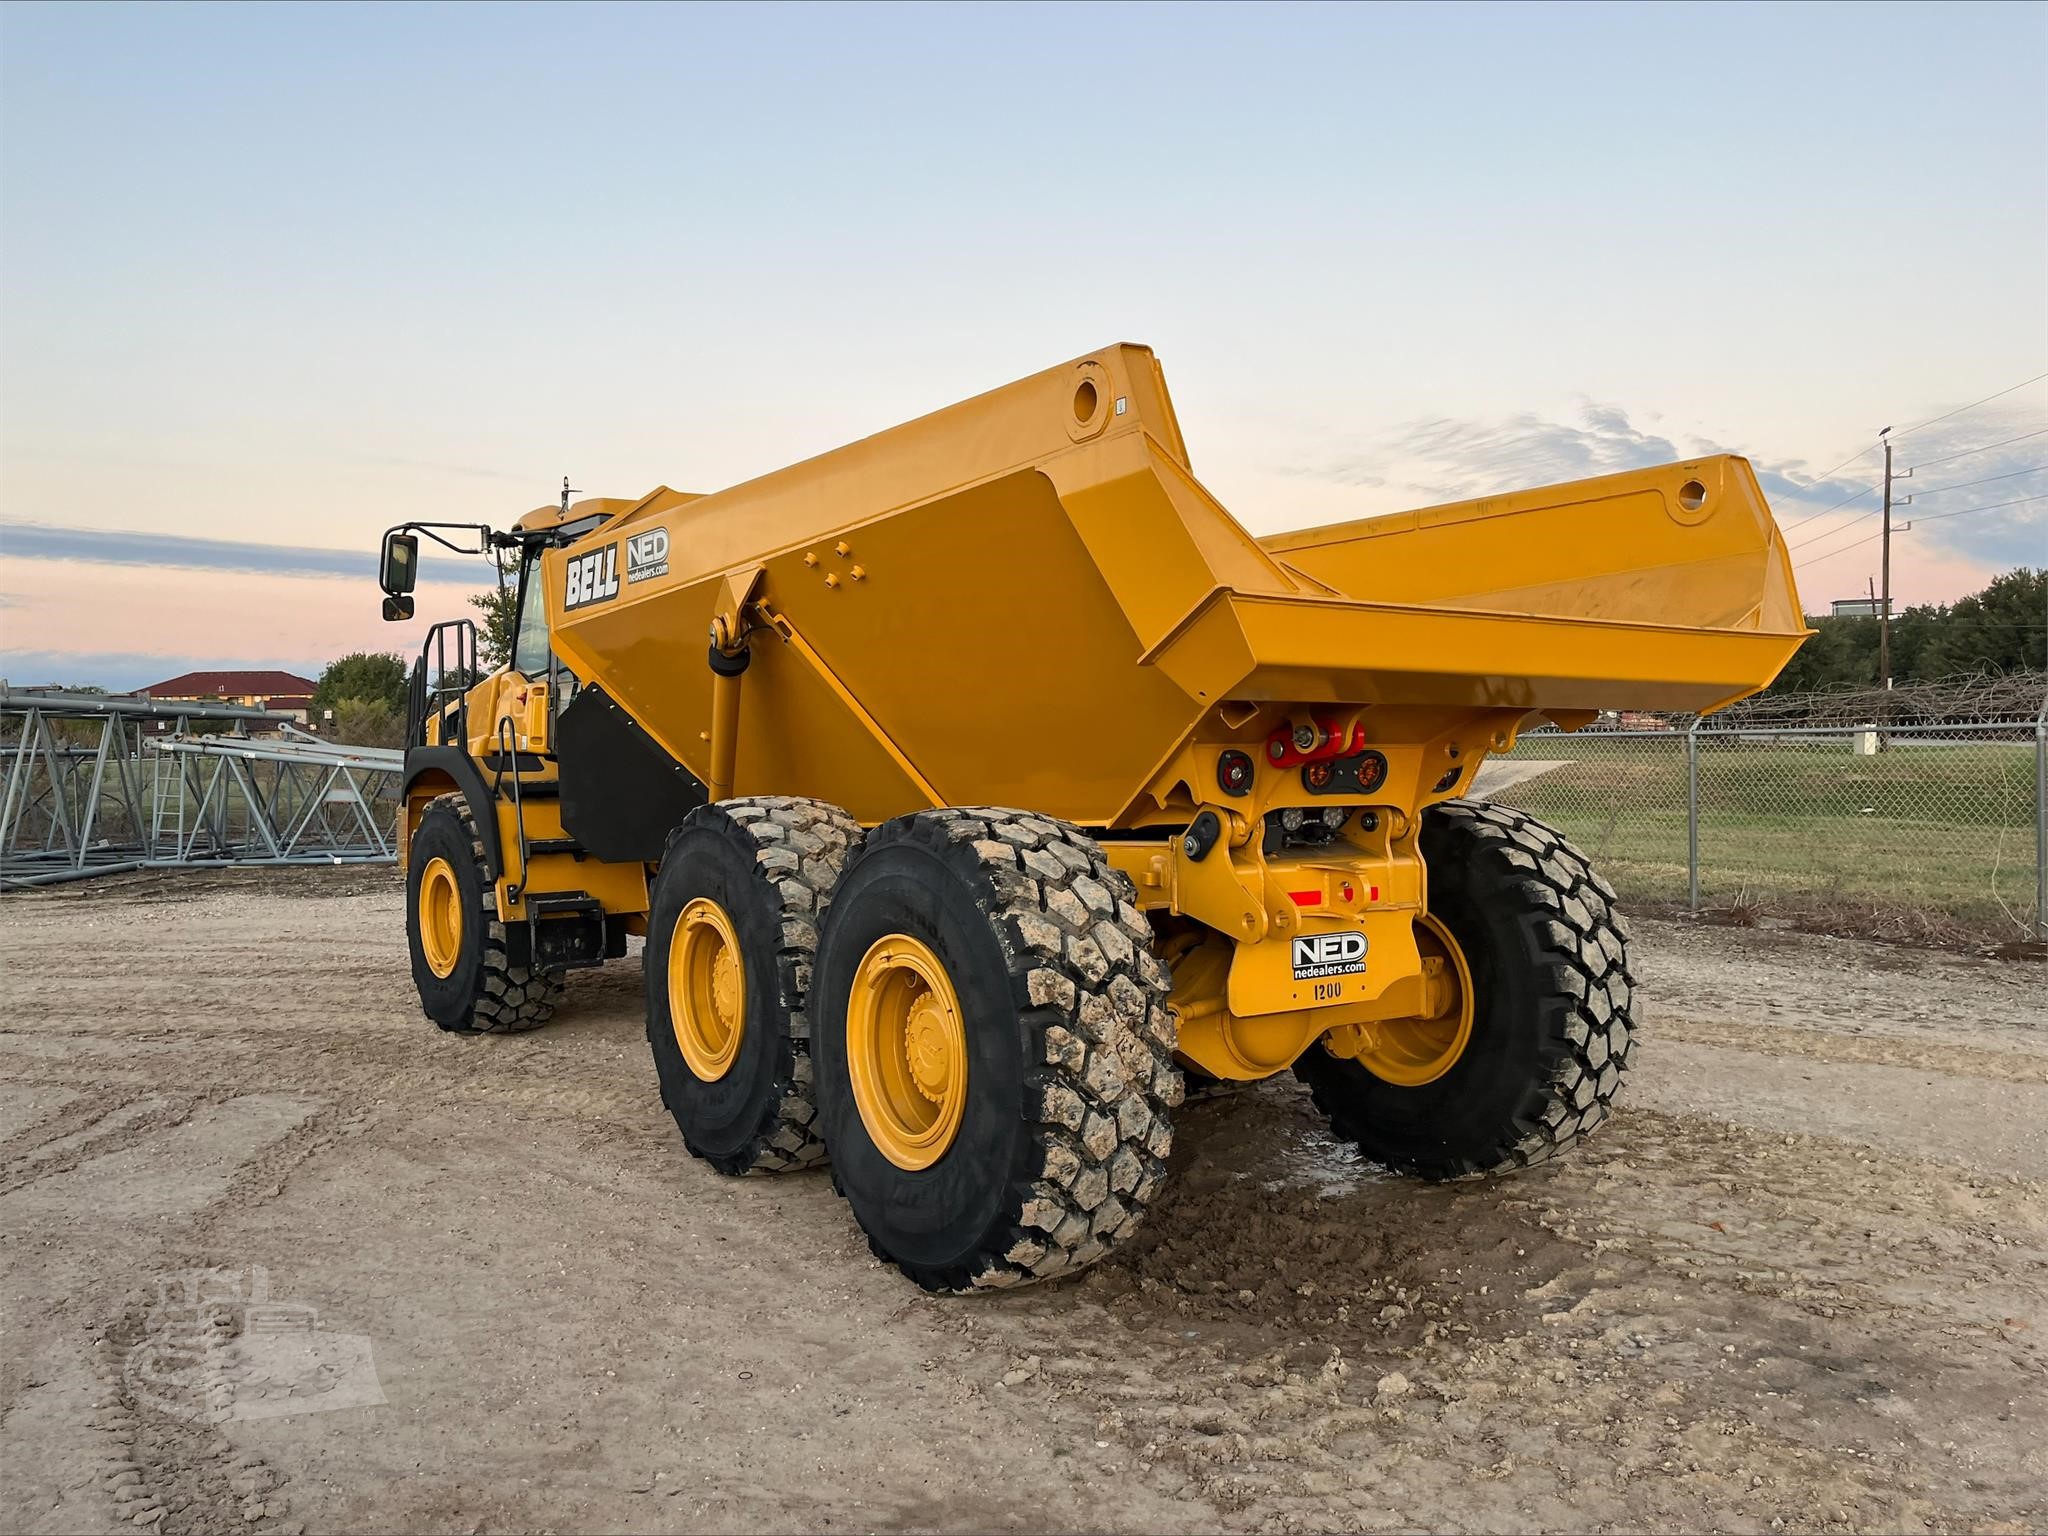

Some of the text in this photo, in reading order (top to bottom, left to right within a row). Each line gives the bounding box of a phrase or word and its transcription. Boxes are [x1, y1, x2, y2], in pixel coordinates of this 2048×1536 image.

[627, 529, 669, 569] NED
[565, 547, 618, 607] BELL
[628, 563, 669, 582] nedealers.com
[1295, 934, 1366, 965] NED
[1294, 963, 1365, 979] nedealers.com
[1314, 982, 1341, 1000] 1200
